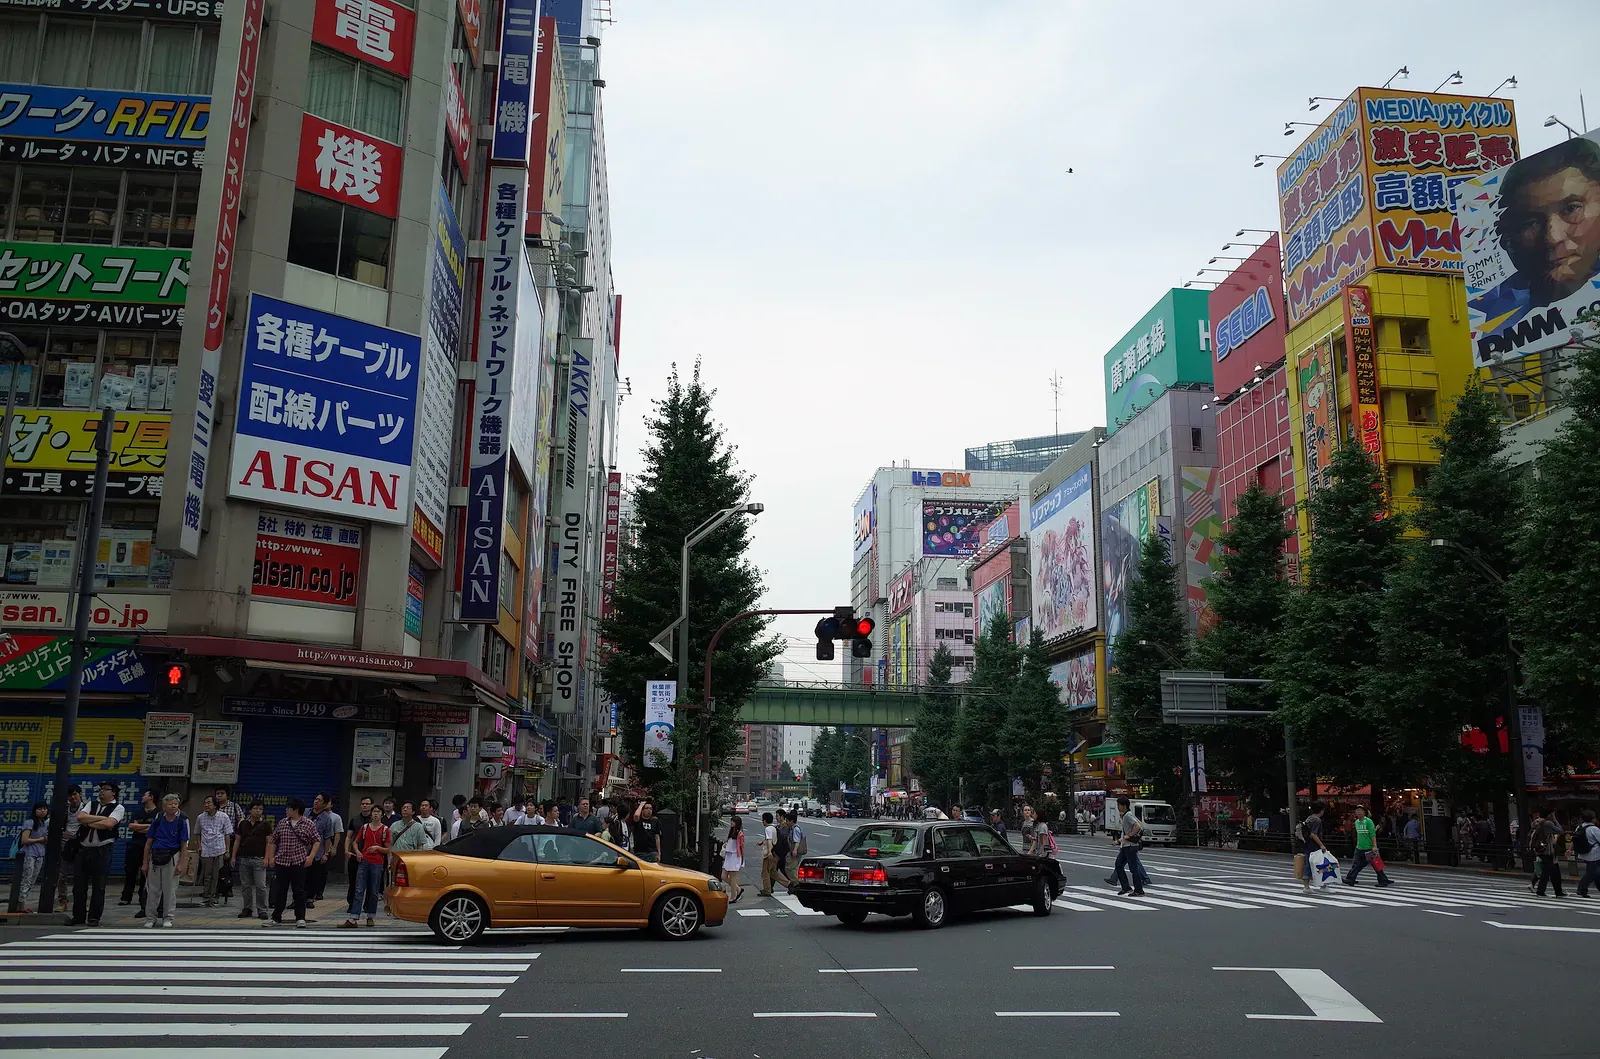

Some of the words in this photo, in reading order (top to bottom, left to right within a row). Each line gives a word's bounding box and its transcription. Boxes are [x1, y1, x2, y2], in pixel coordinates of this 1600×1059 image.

[499, 8, 533, 134] 三電機
[1366, 97, 1513, 128] MEDIAリサイクル
[315, 128, 382, 204] 機
[1279, 98, 1357, 196] MEDIAリサイクル
[1283, 129, 1361, 232] 激安販売
[1286, 173, 1363, 276] 高額買取
[1287, 226, 1373, 321] Mulan
[1396, 255, 1441, 270] ムーラン
[1467, 255, 1494, 275] DMM
[1469, 269, 1485, 283] 3D
[1471, 272, 1497, 291] PRINT
[256, 312, 412, 381] 各種ケーブル
[478, 182, 518, 455] 各種ケーブル・ネットワーク機器
[1216, 285, 1276, 362] SEGA
[1354, 327, 1370, 336] DVD
[571, 348, 590, 418] AKKY
[1358, 353, 1370, 361] CD
[248, 382, 405, 445] 配線パーツ
[565, 399, 577, 489] INTERNATIONAL
[239, 449, 400, 510] AISAN
[1031, 488, 1062, 524] ソフマップ
[284, 519, 306, 538] 特約
[312, 523, 333, 542] 在庫
[338, 528, 360, 545] 直販
[469, 473, 498, 603] AISAN
[562, 512, 581, 569] DUTY
[252, 553, 357, 601] aisan.co.jp
[560, 577, 577, 633] FREE
[297, 648, 414, 669] http://www.aisan.co.jp
[558, 641, 575, 700] SHOP
[272, 705, 295, 715] Since
[295, 703, 327, 716] 1949
